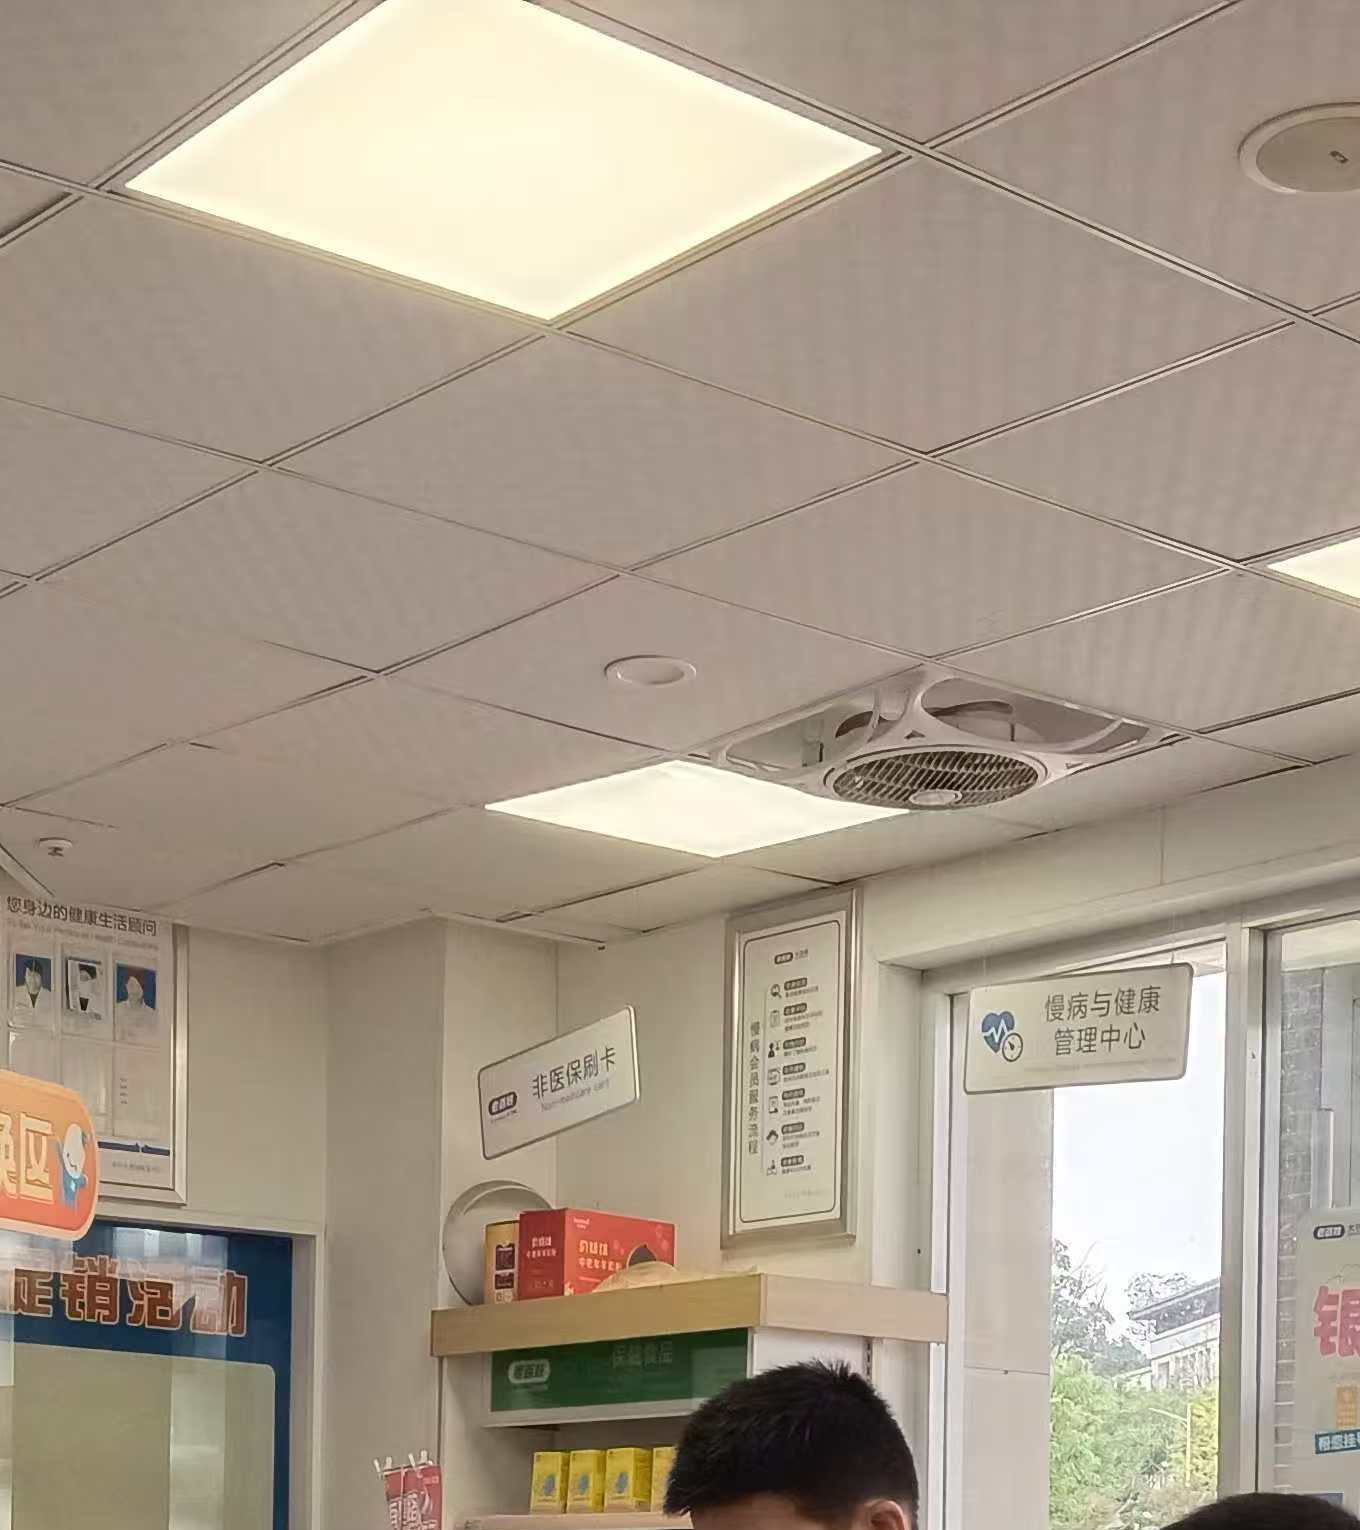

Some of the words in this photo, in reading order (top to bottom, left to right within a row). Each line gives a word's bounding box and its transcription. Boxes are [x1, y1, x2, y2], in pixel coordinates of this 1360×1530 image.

[1045, 985, 1162, 1023] 慢病与健康
[1054, 1022, 1146, 1057] 管理中心
[532, 1047, 617, 1100] 非医保刷卡
